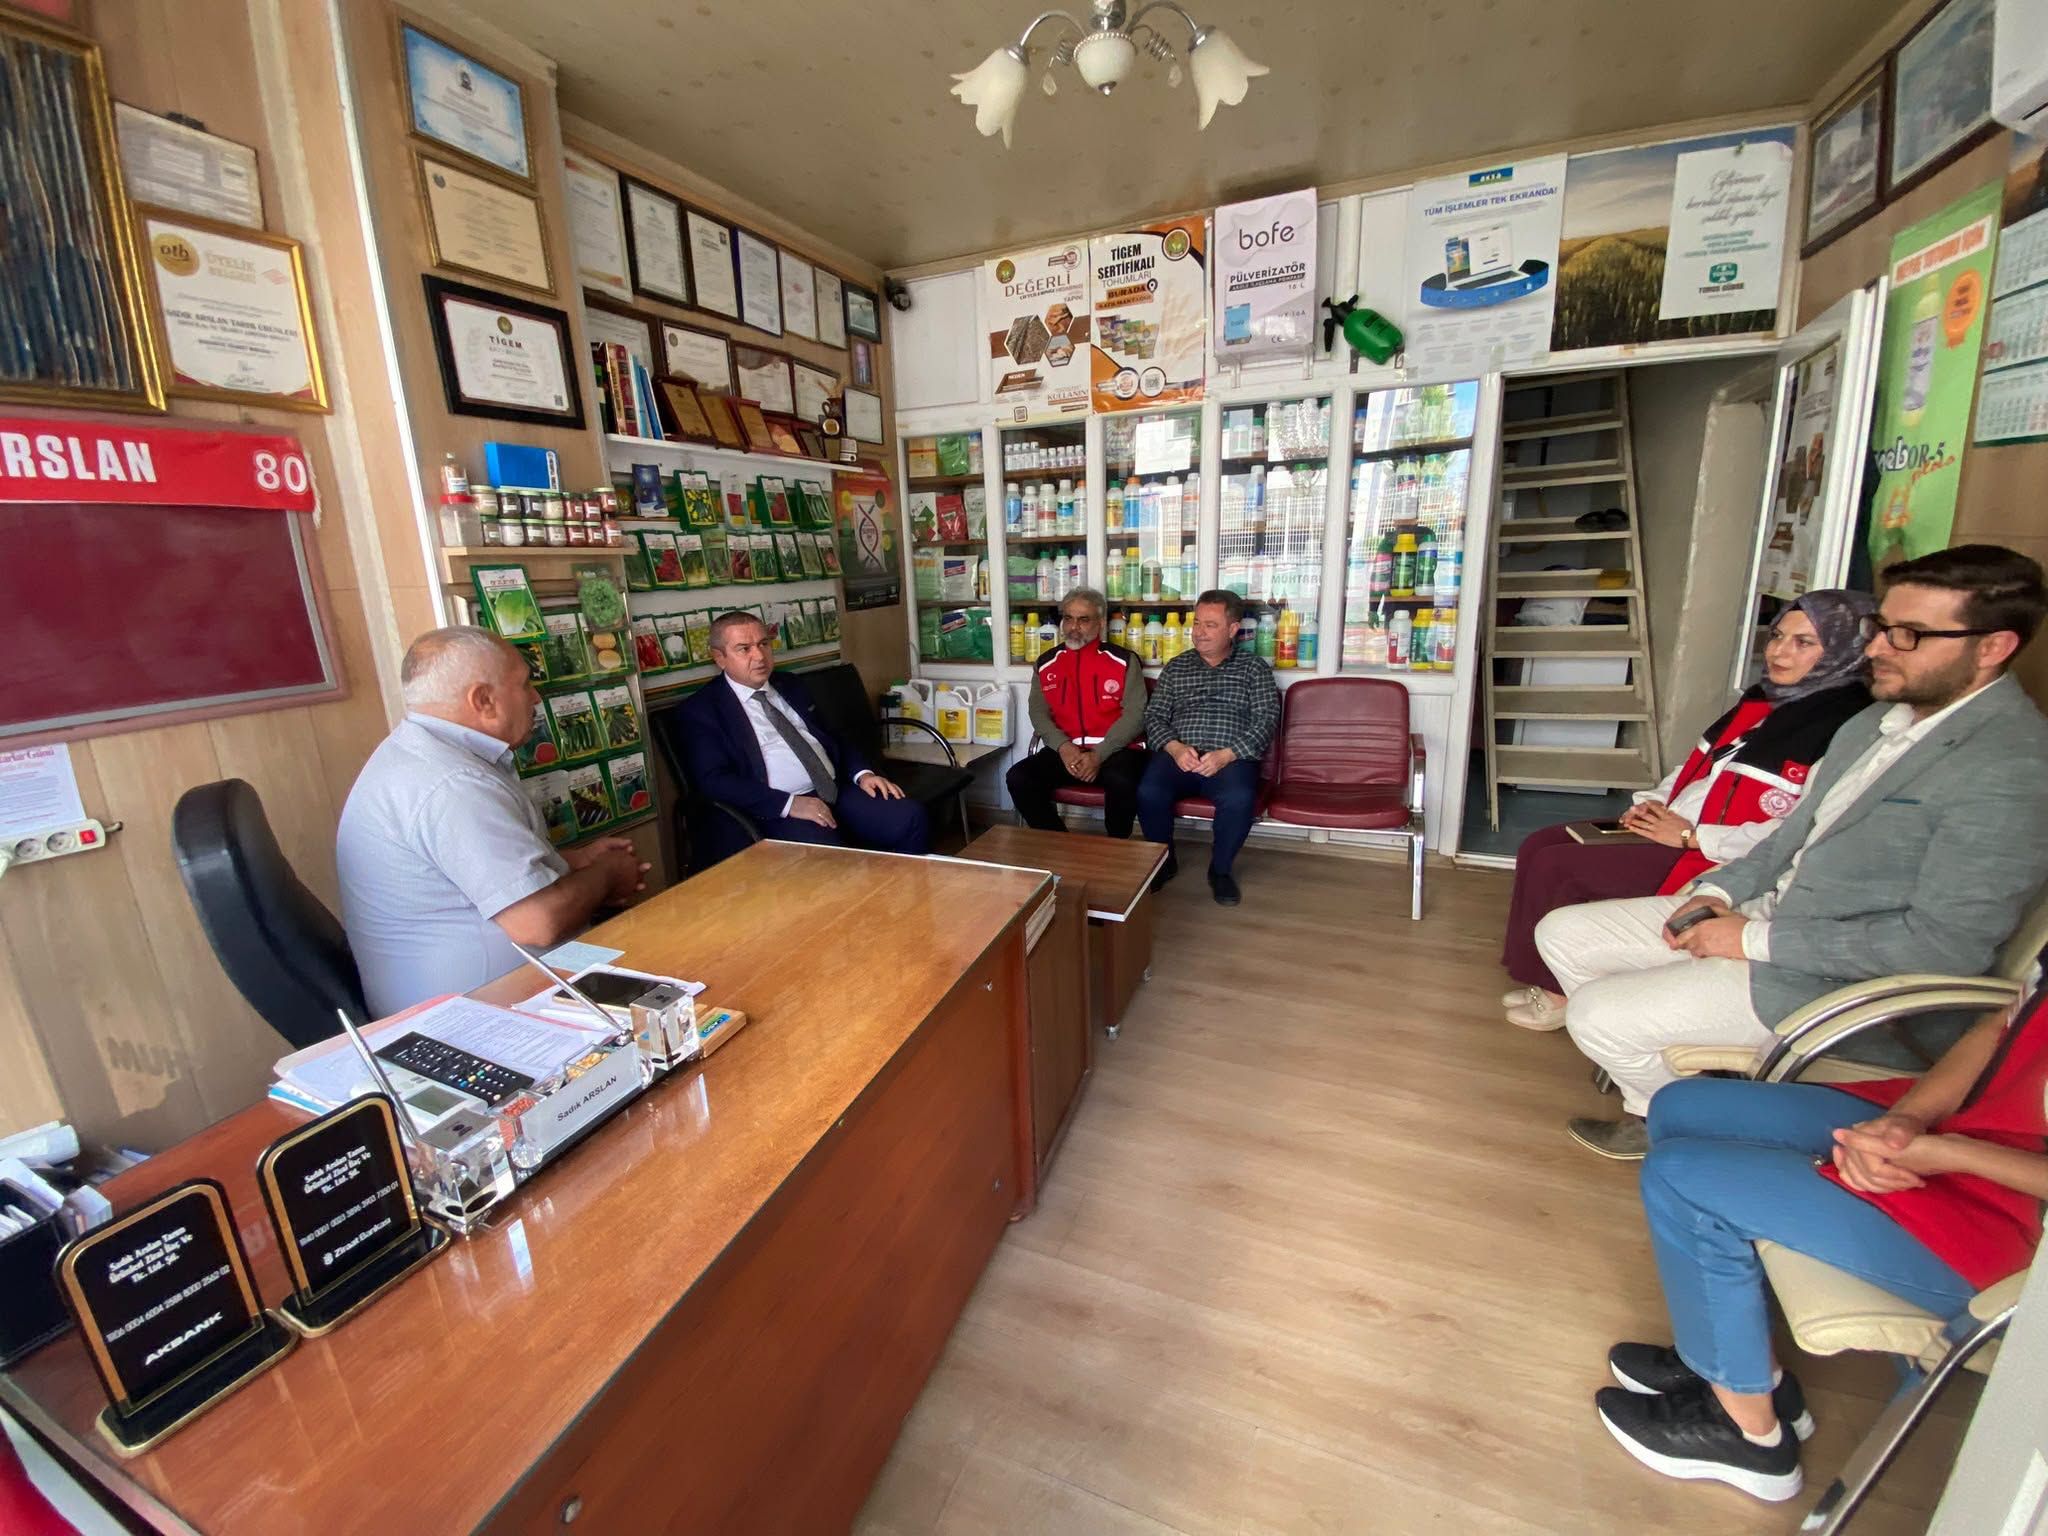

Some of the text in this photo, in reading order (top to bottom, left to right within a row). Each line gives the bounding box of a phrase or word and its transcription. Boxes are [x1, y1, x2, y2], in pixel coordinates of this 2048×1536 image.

[1490, 195, 1507, 205] TEK
[1509, 187, 1558, 202] EKRANDA!
[1239, 221, 1295, 250] bofe
[1111, 243, 1142, 261] TİGEM
[1098, 256, 1155, 280] SERTİFİKALI
[1102, 270, 1152, 288] TOHUMLARI
[1230, 262, 1306, 283] PÜLVERİZATÖR
[1005, 271, 1070, 298] DEĞERLİ
[489, 334, 523, 349] TİGEM
[0, 432, 309, 494] RSLAN 80
[557, 1075, 617, 1121] Sadık ARSLAN
[145, 1312, 222, 1365] AKBANK
